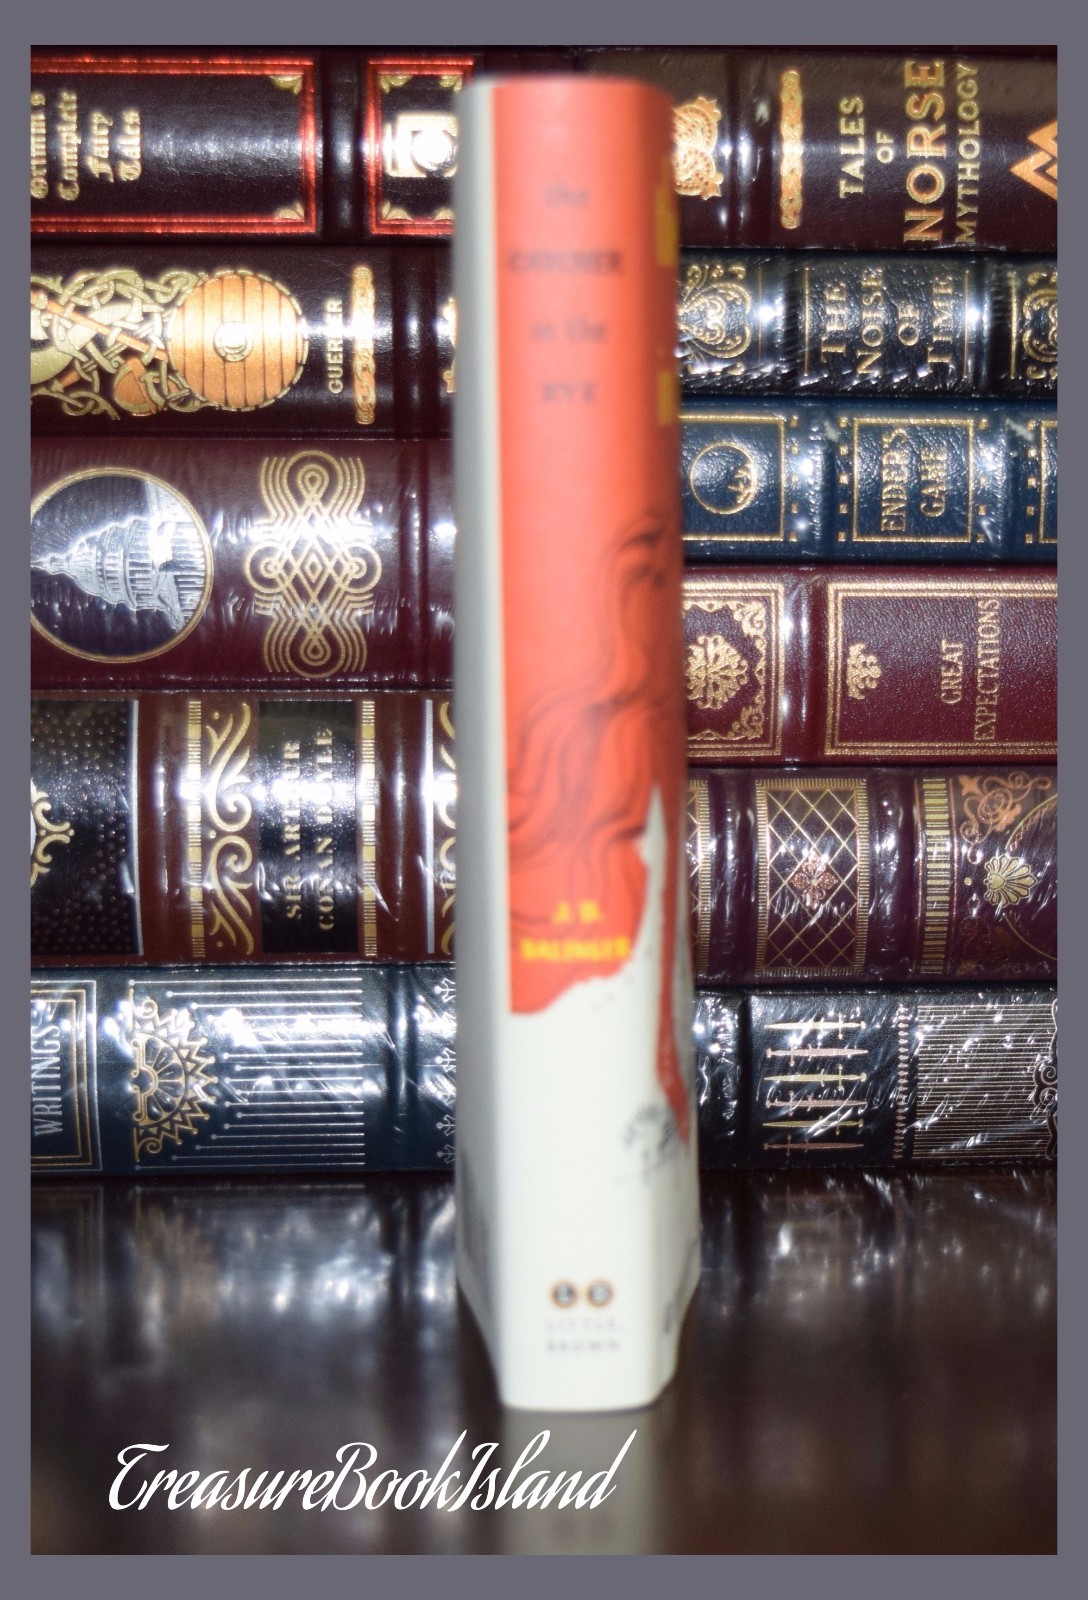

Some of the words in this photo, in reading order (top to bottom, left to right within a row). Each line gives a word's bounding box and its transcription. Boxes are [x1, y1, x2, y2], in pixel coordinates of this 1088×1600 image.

[31, 91, 48, 199] Grimms
[57, 89, 80, 201] Complete
[86, 108, 114, 183] Fairy
[118, 108, 142, 181] Tales
[839, 97, 865, 199] TALES
[876, 131, 894, 164] OF
[903, 60, 946, 243] NORSE
[955, 62, 980, 244] MYTHOLOGY
[325, 299, 344, 394] GUERER
[821, 281, 847, 363] THE
[856, 268, 884, 376] NOISE
[898, 304, 920, 346] OF
[927, 275, 953, 374] TIME
[920, 446, 947, 517] GAME
[940, 639, 964, 704] GREAT
[974, 600, 1001, 741] EXPECTATIONS
[285, 874, 302, 919] SIR
[31, 1025, 63, 1136] WRITINGS
